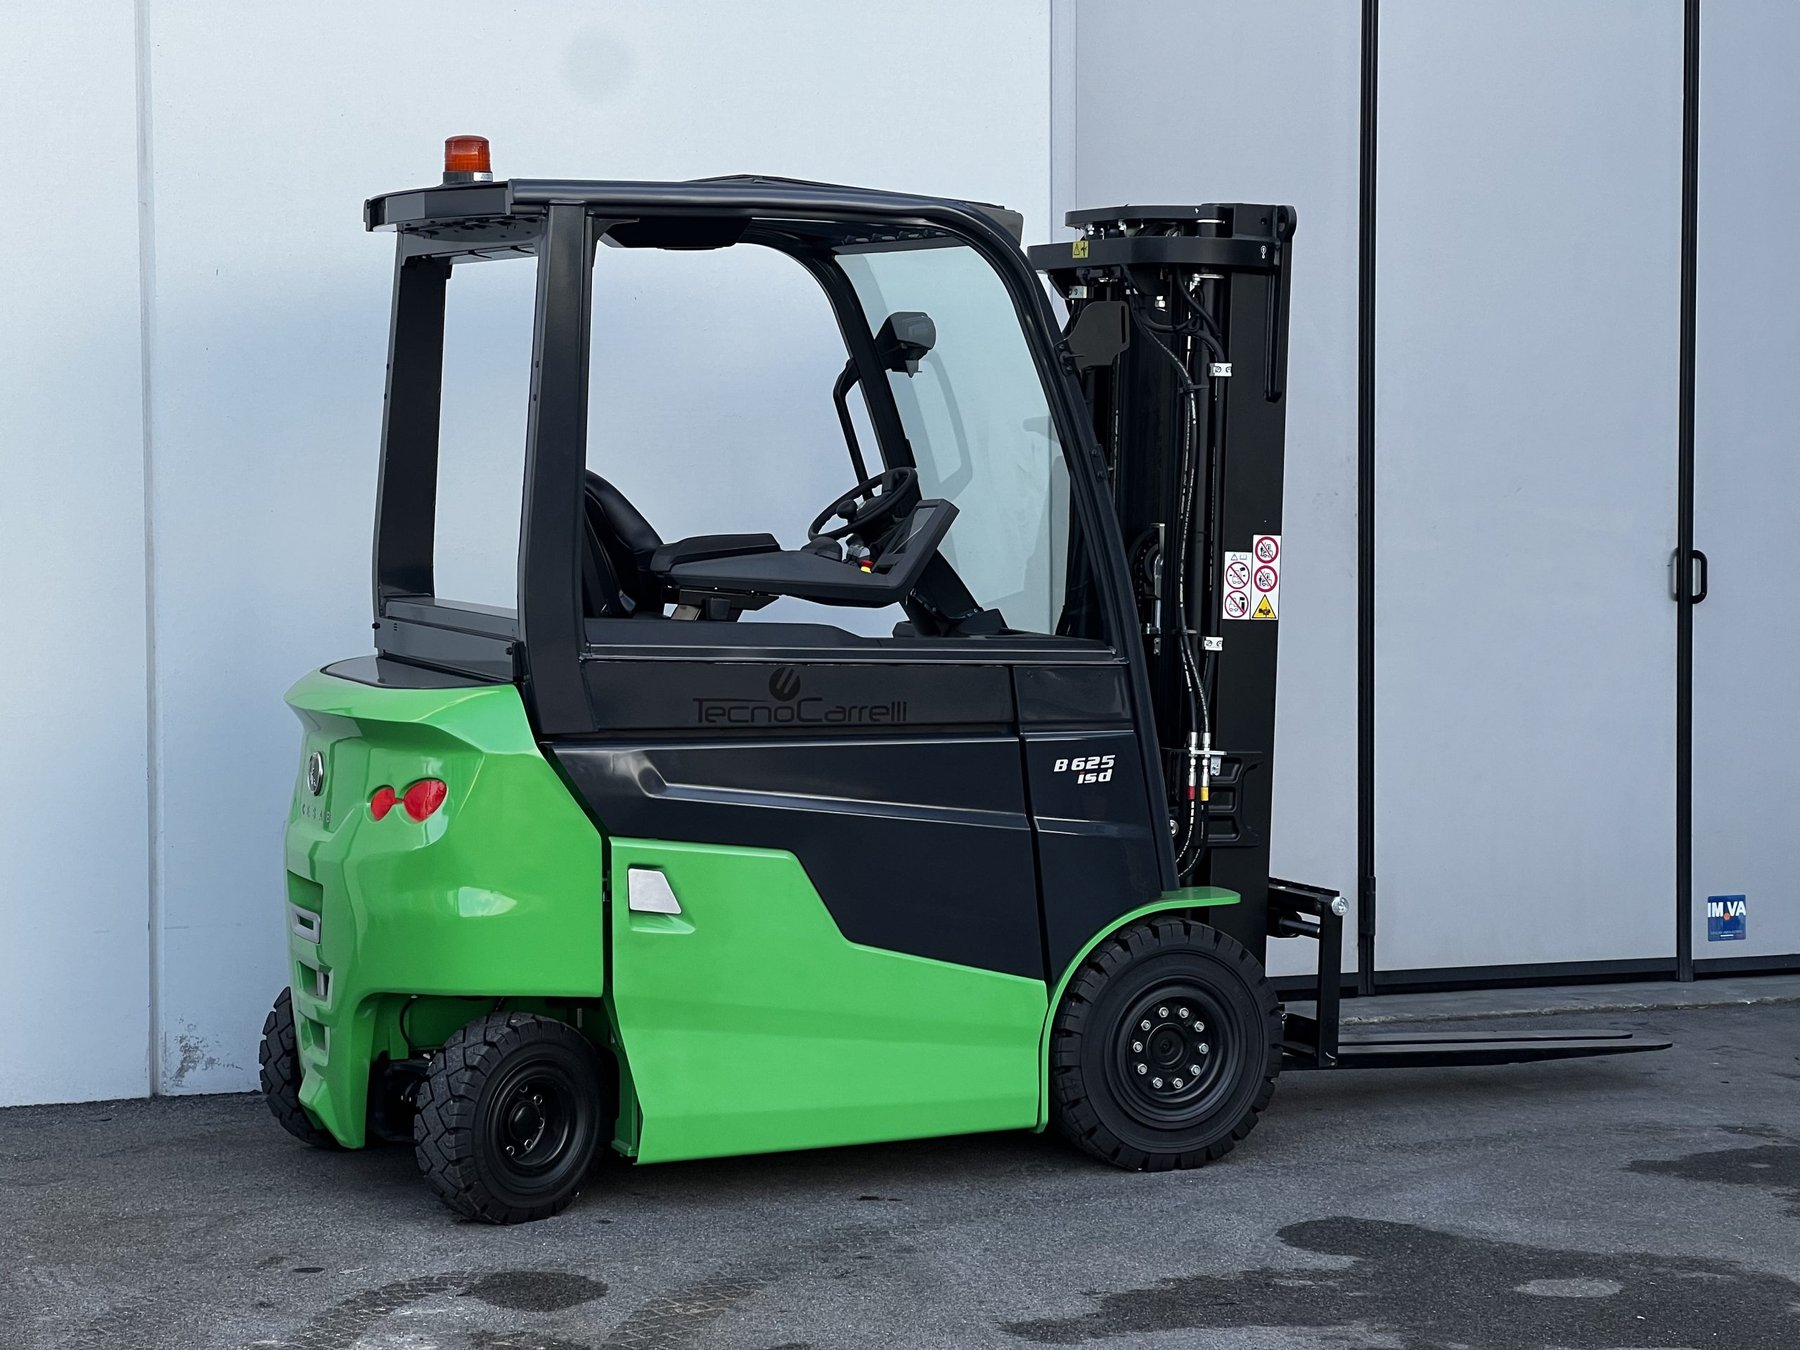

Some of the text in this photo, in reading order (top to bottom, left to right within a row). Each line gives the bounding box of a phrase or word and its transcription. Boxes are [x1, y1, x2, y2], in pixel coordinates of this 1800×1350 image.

[693, 697, 907, 723] TecnoCarrelli
[1053, 755, 1116, 773] B 625
